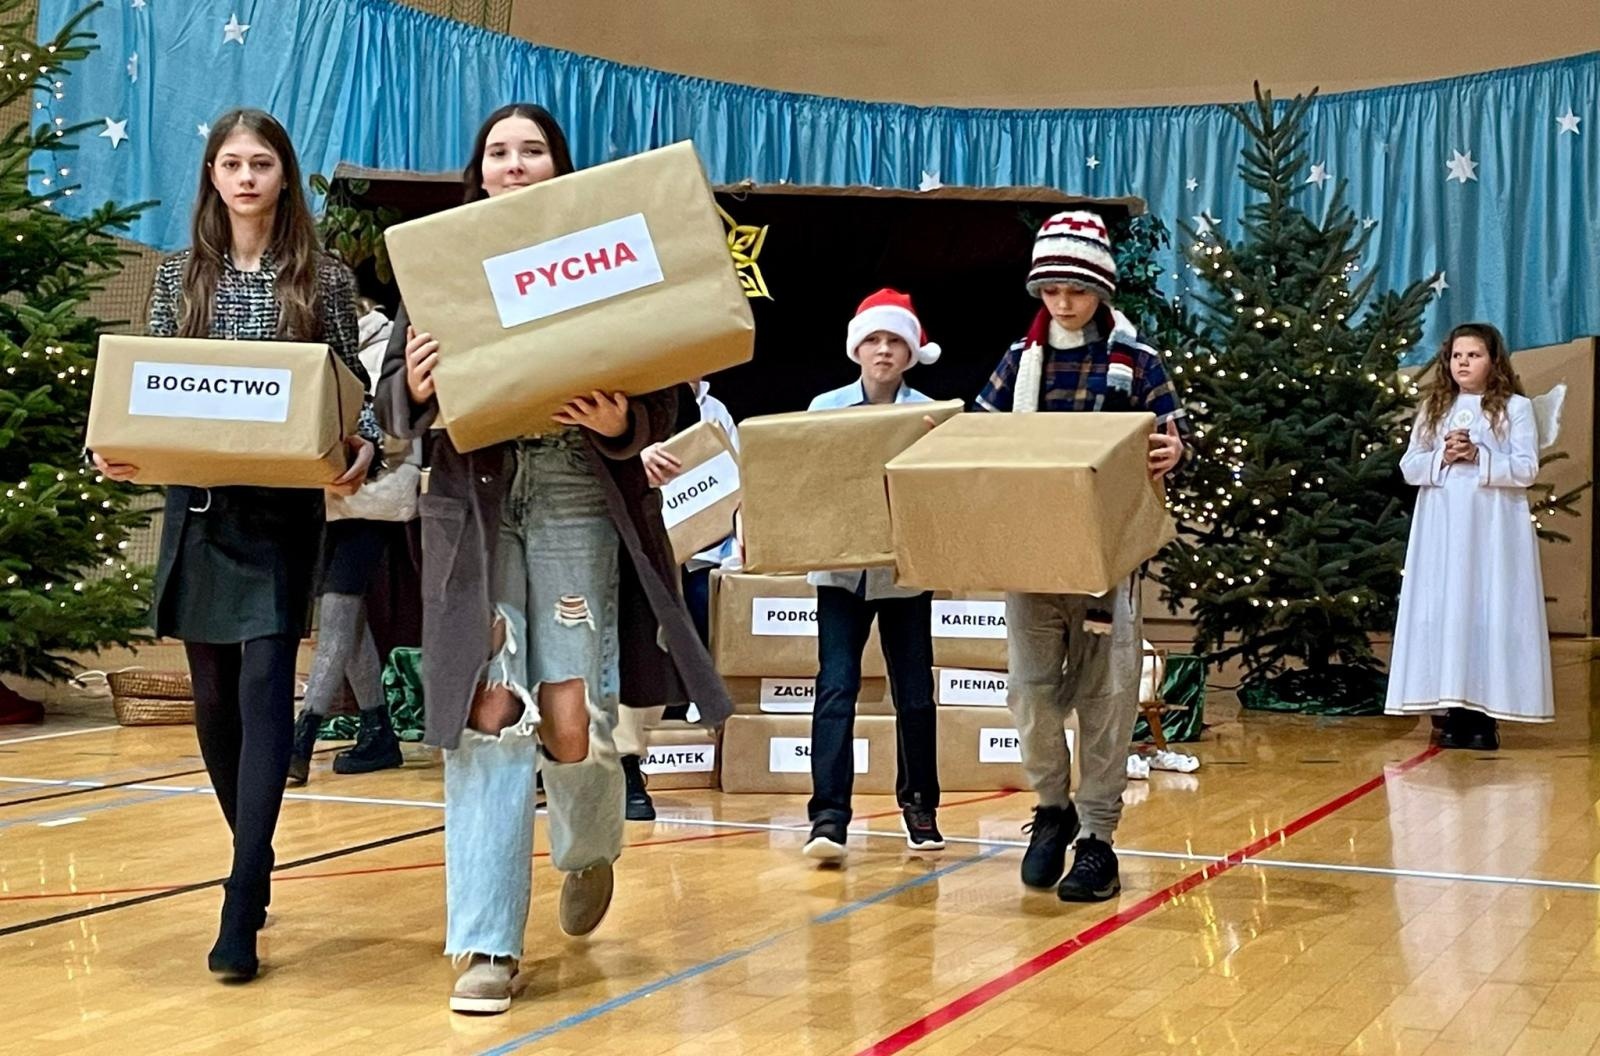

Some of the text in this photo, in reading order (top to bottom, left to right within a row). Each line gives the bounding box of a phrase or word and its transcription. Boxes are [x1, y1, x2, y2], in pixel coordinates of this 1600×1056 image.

[514, 242, 638, 295] PYCHA
[146, 375, 281, 396] BOGACTWO
[666, 475, 719, 509] URODA
[941, 614, 1007, 626] KARIERA
[774, 686, 814, 697] ZACH
[950, 679, 1009, 692] PIENIĄD
